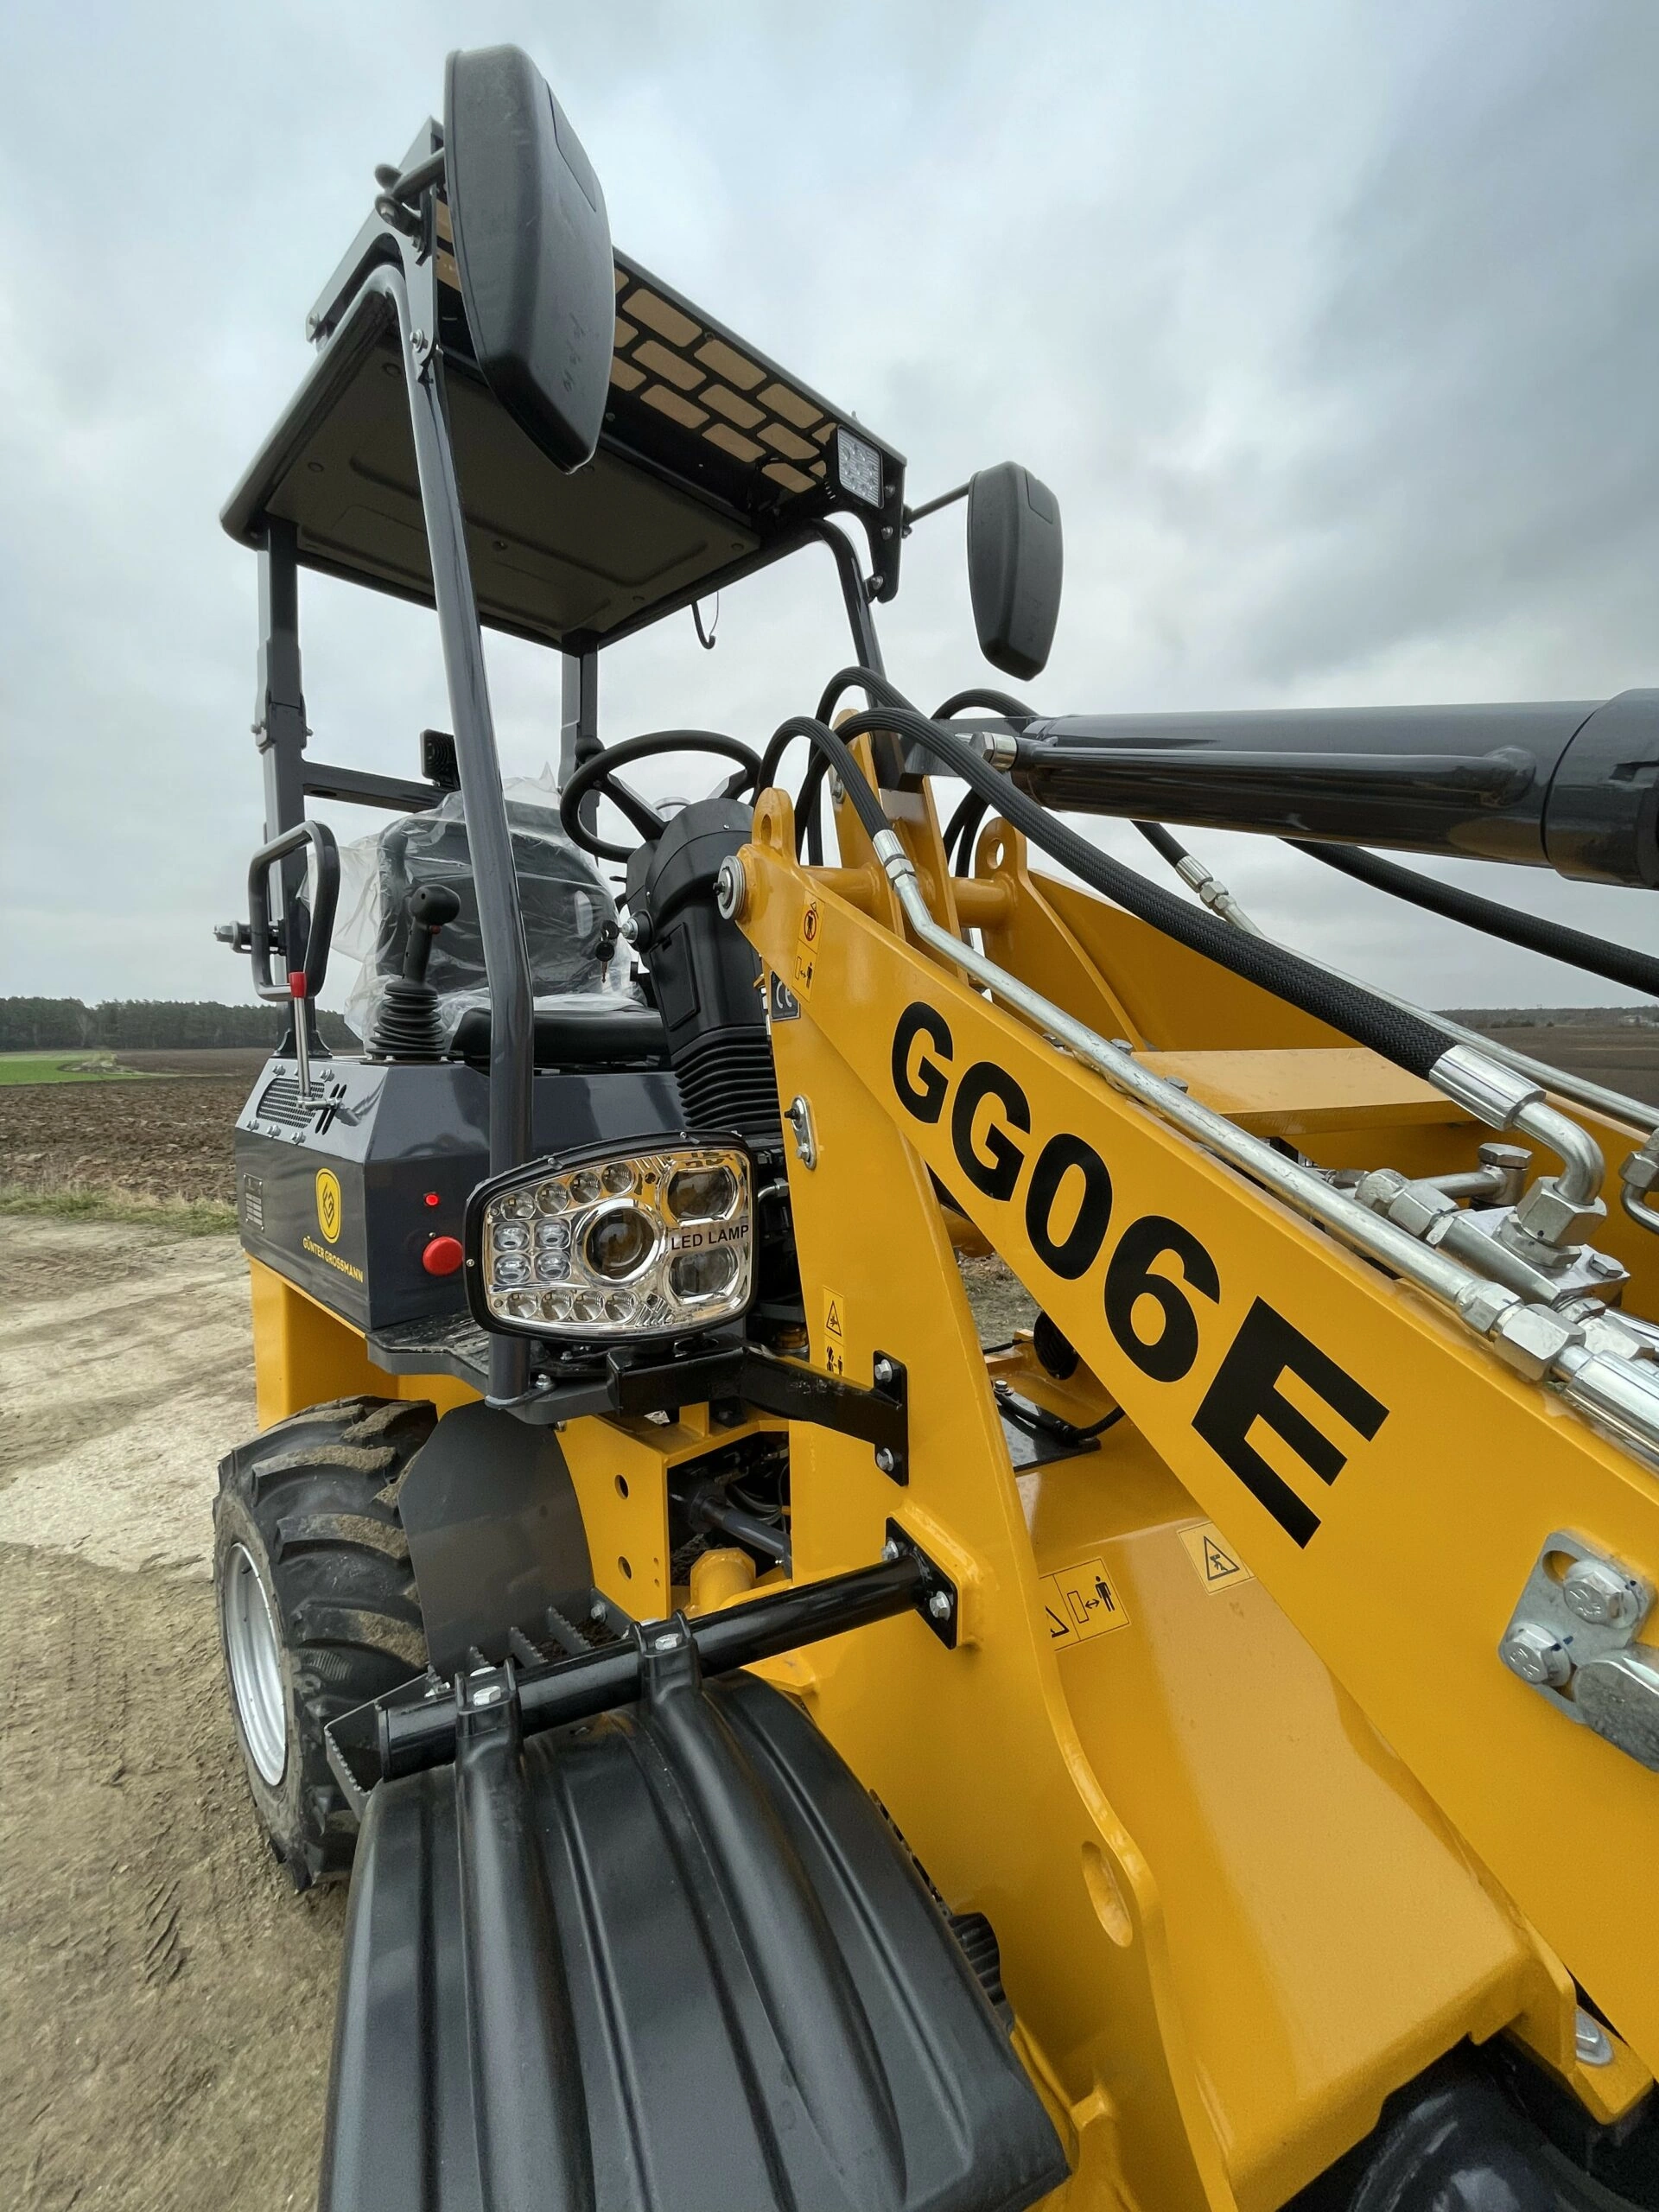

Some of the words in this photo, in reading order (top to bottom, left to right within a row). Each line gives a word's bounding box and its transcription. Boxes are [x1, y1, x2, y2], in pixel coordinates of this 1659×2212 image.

[302, 1236, 325, 1260] GÜNTER
[324, 1250, 364, 1283] GROSSMANN
[671, 1234, 702, 1250] LED
[709, 1225, 749, 1244] LAMP
[891, 1001, 1390, 1549] GG06E
